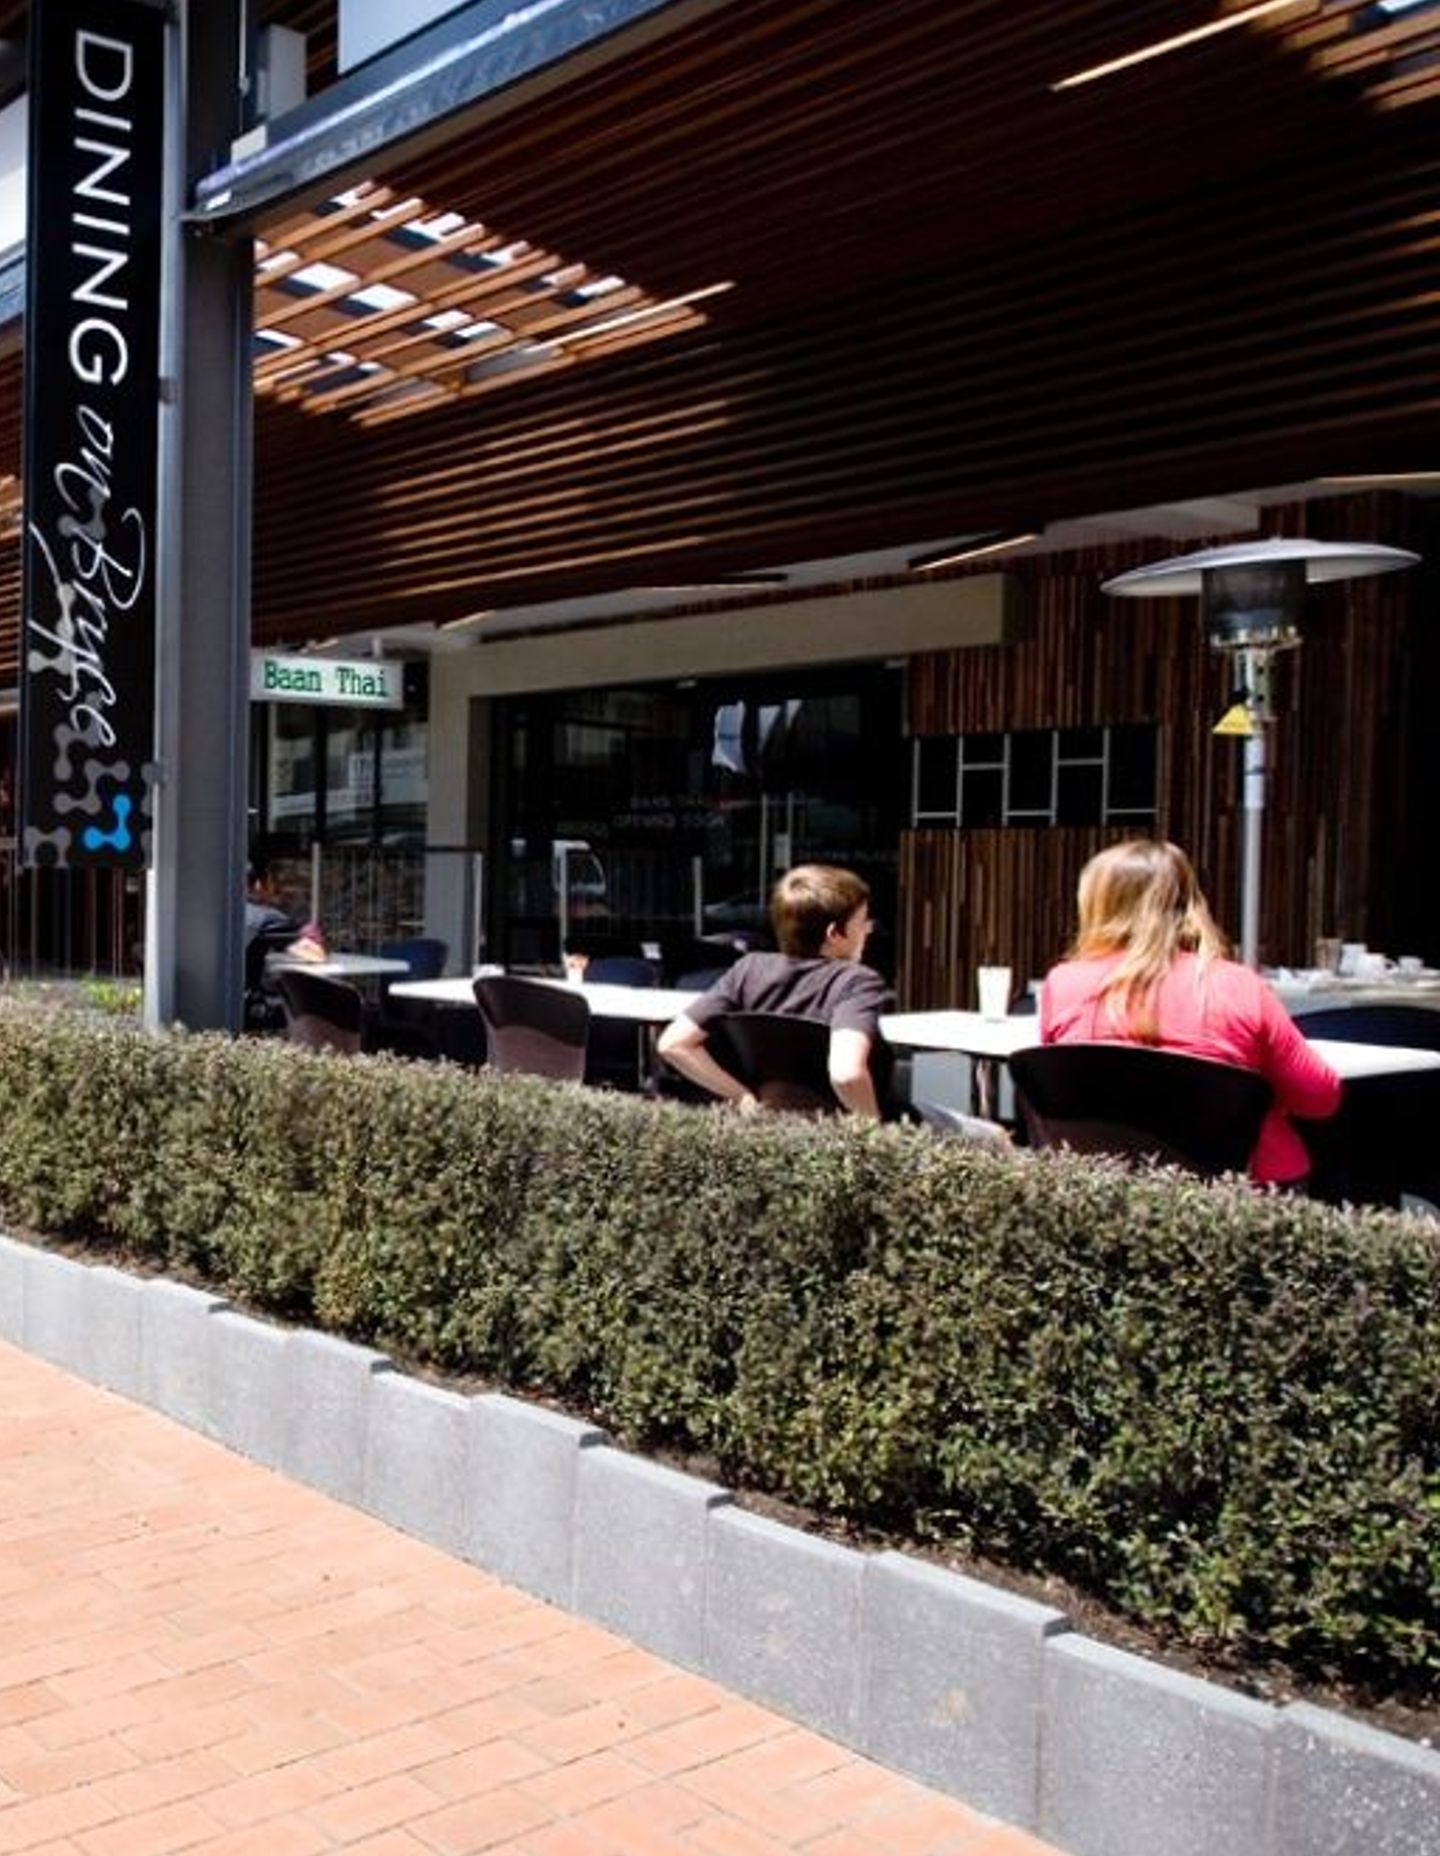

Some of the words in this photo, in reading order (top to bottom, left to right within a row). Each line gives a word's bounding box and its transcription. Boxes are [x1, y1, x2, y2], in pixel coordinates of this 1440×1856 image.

[68, 28, 134, 387] DINING
[53, 404, 115, 514] on
[27, 506, 147, 750] Bryce
[263, 659, 322, 692] Baan
[336, 666, 391, 698] Thai
